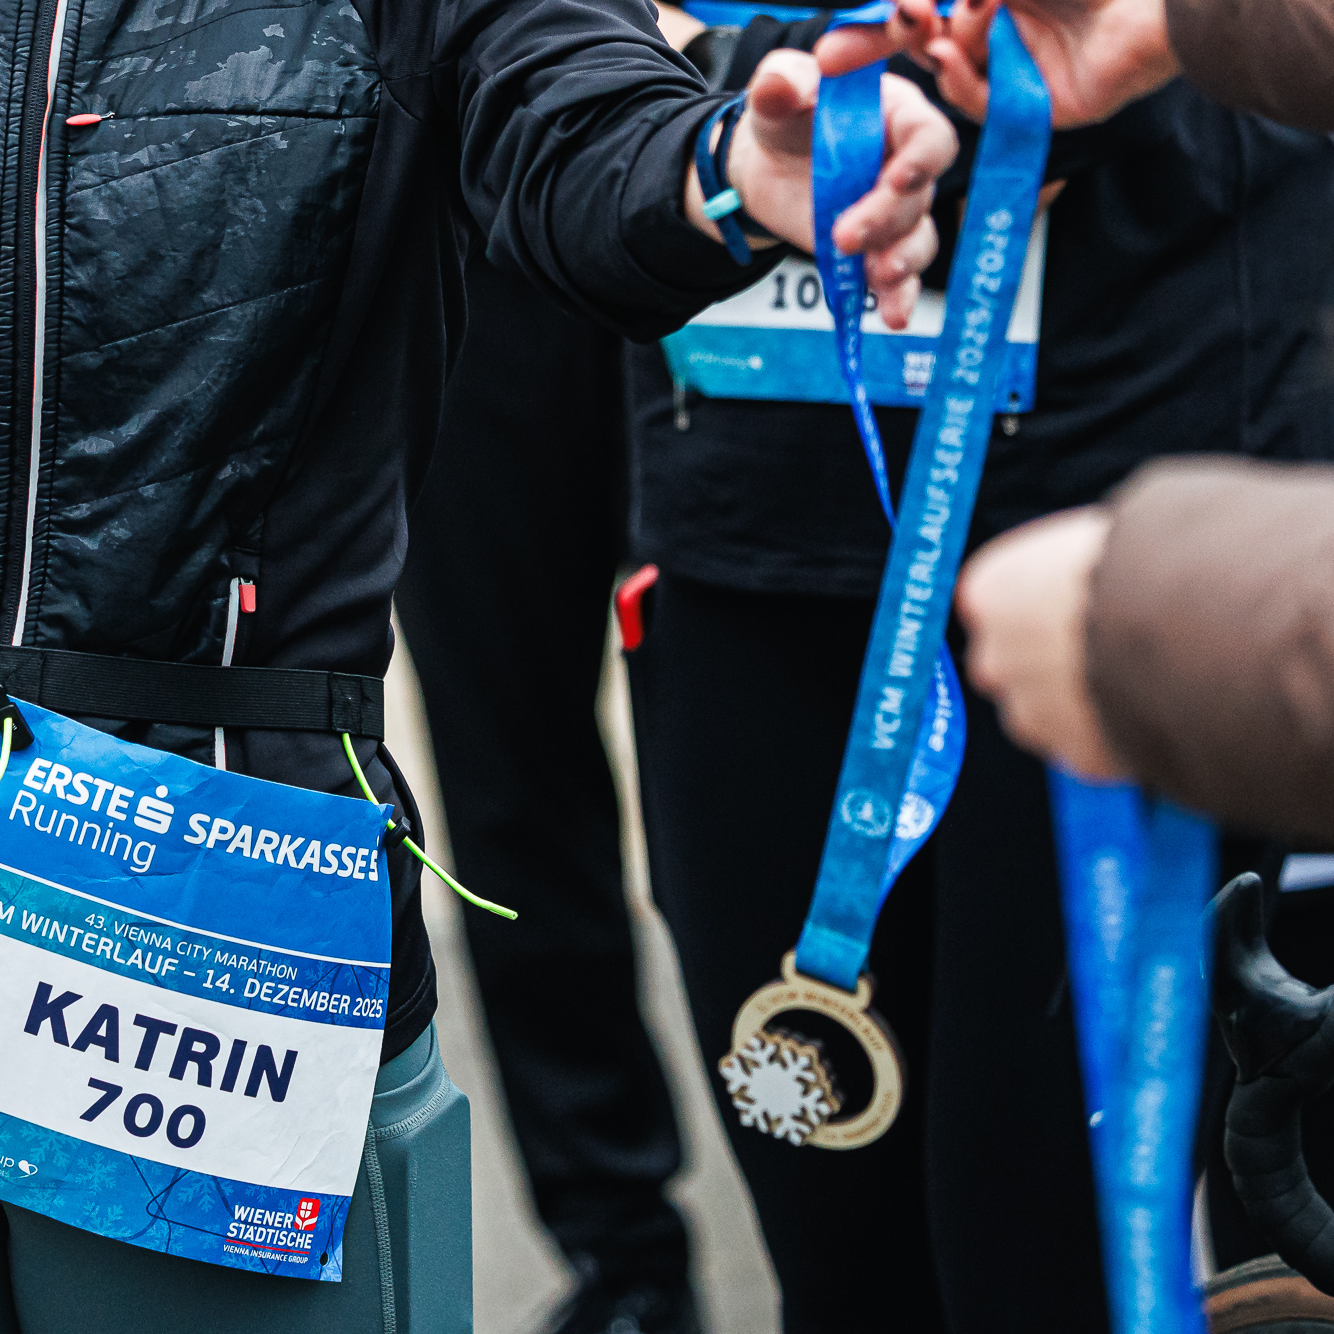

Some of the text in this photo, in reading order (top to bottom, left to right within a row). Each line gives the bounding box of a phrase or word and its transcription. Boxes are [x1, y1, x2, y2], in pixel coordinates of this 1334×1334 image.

[887, 396, 975, 678] WINTERLAUFSERIE
[871, 685, 906, 750] VCM
[8, 789, 157, 874] Running
[22, 757, 369, 881] ERSTE SPARKASSE
[20, 909, 180, 978] WINTERLAUF
[202, 969, 236, 995] 14.
[243, 977, 351, 1016] DEZEMBER
[352, 997, 383, 1019] 2025
[84, 912, 298, 981] 43. VIENNA CITY MARATHON
[23, 981, 299, 1103] KATRIN
[79, 1076, 207, 1149] 700
[226, 1222, 314, 1250] STÄDTISCHE
[234, 1204, 294, 1229] WIENER
[223, 1244, 309, 1265] VIENNA INSURANCE GROUP
